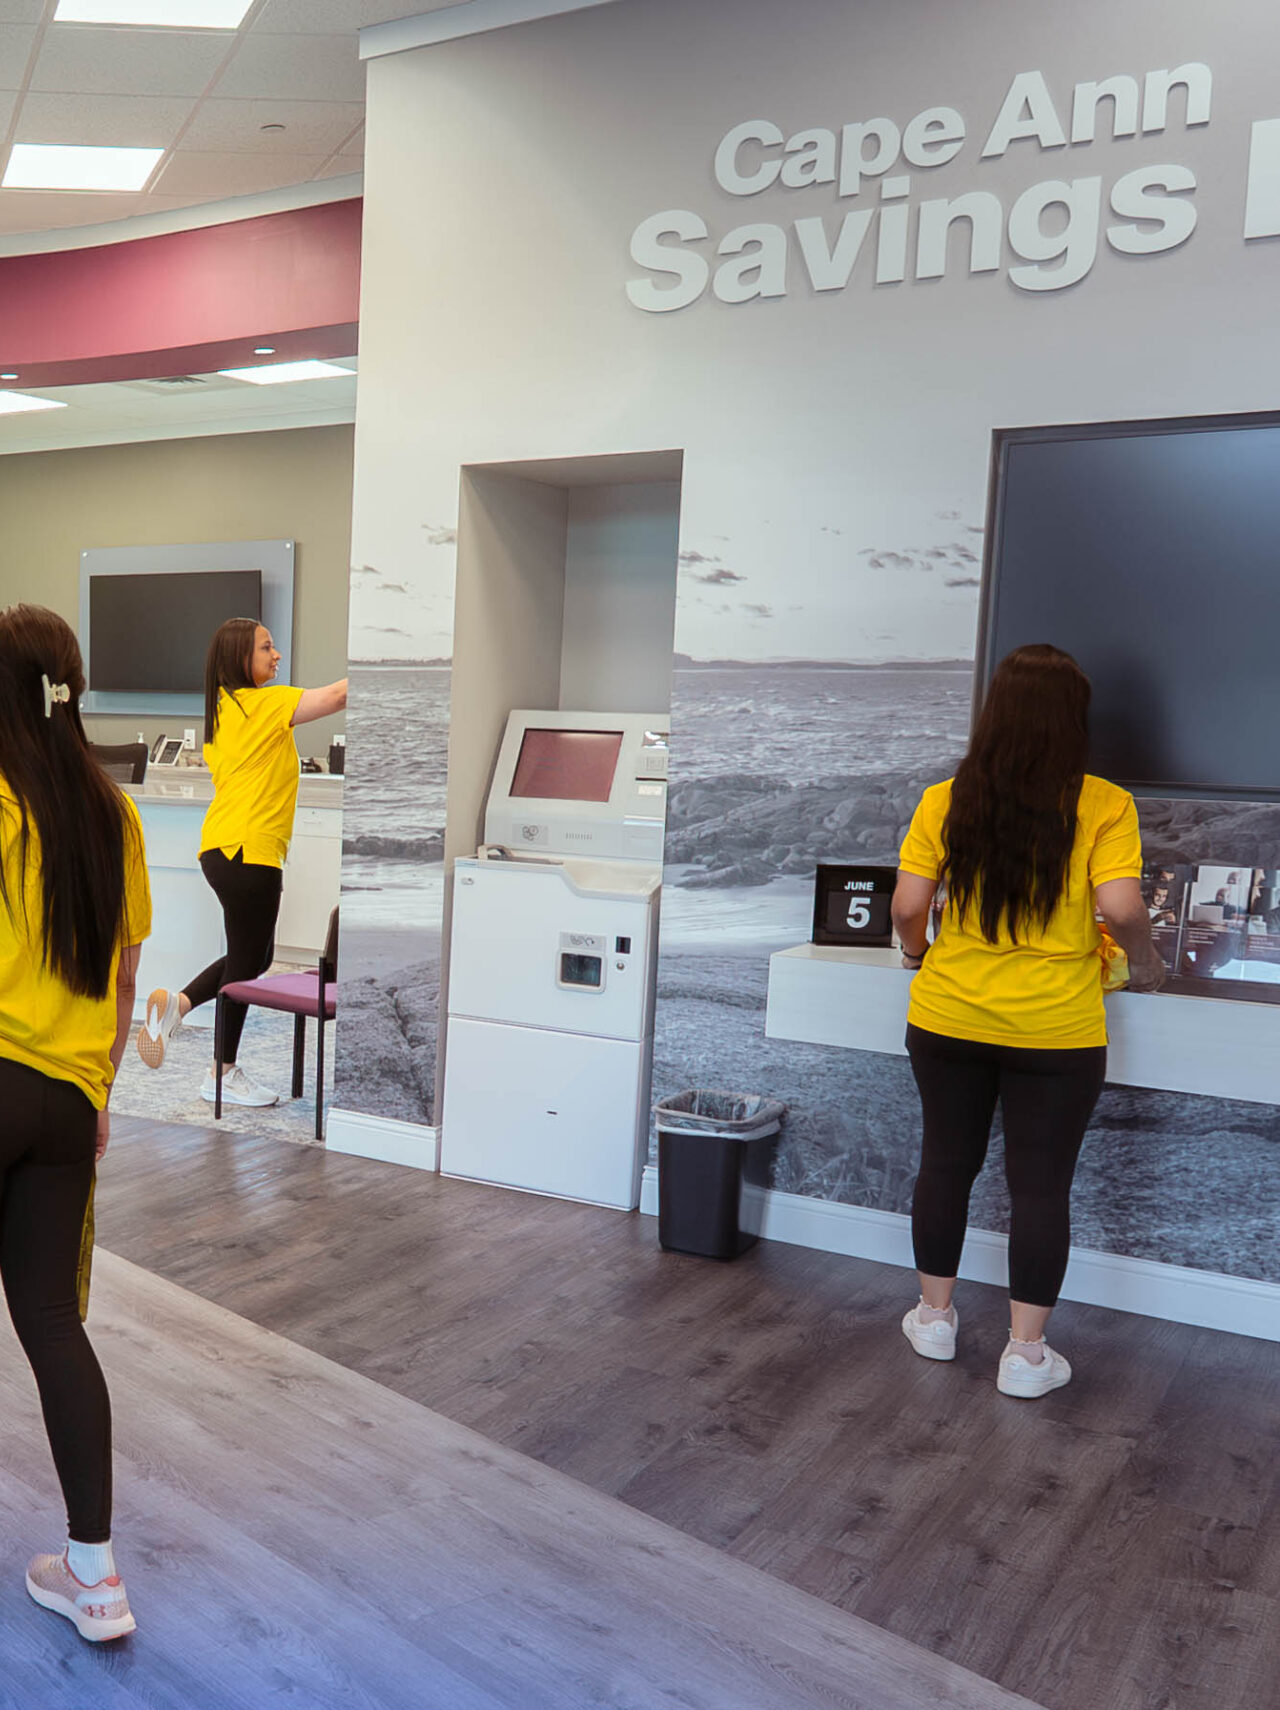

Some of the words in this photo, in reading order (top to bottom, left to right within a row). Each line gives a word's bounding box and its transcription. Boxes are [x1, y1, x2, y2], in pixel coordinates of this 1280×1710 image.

[714, 106, 965, 198] Cape
[980, 61, 1213, 160] Ann
[625, 163, 1198, 313] Savings
[843, 881, 875, 891] JUNE
[846, 897, 871, 929] 5
